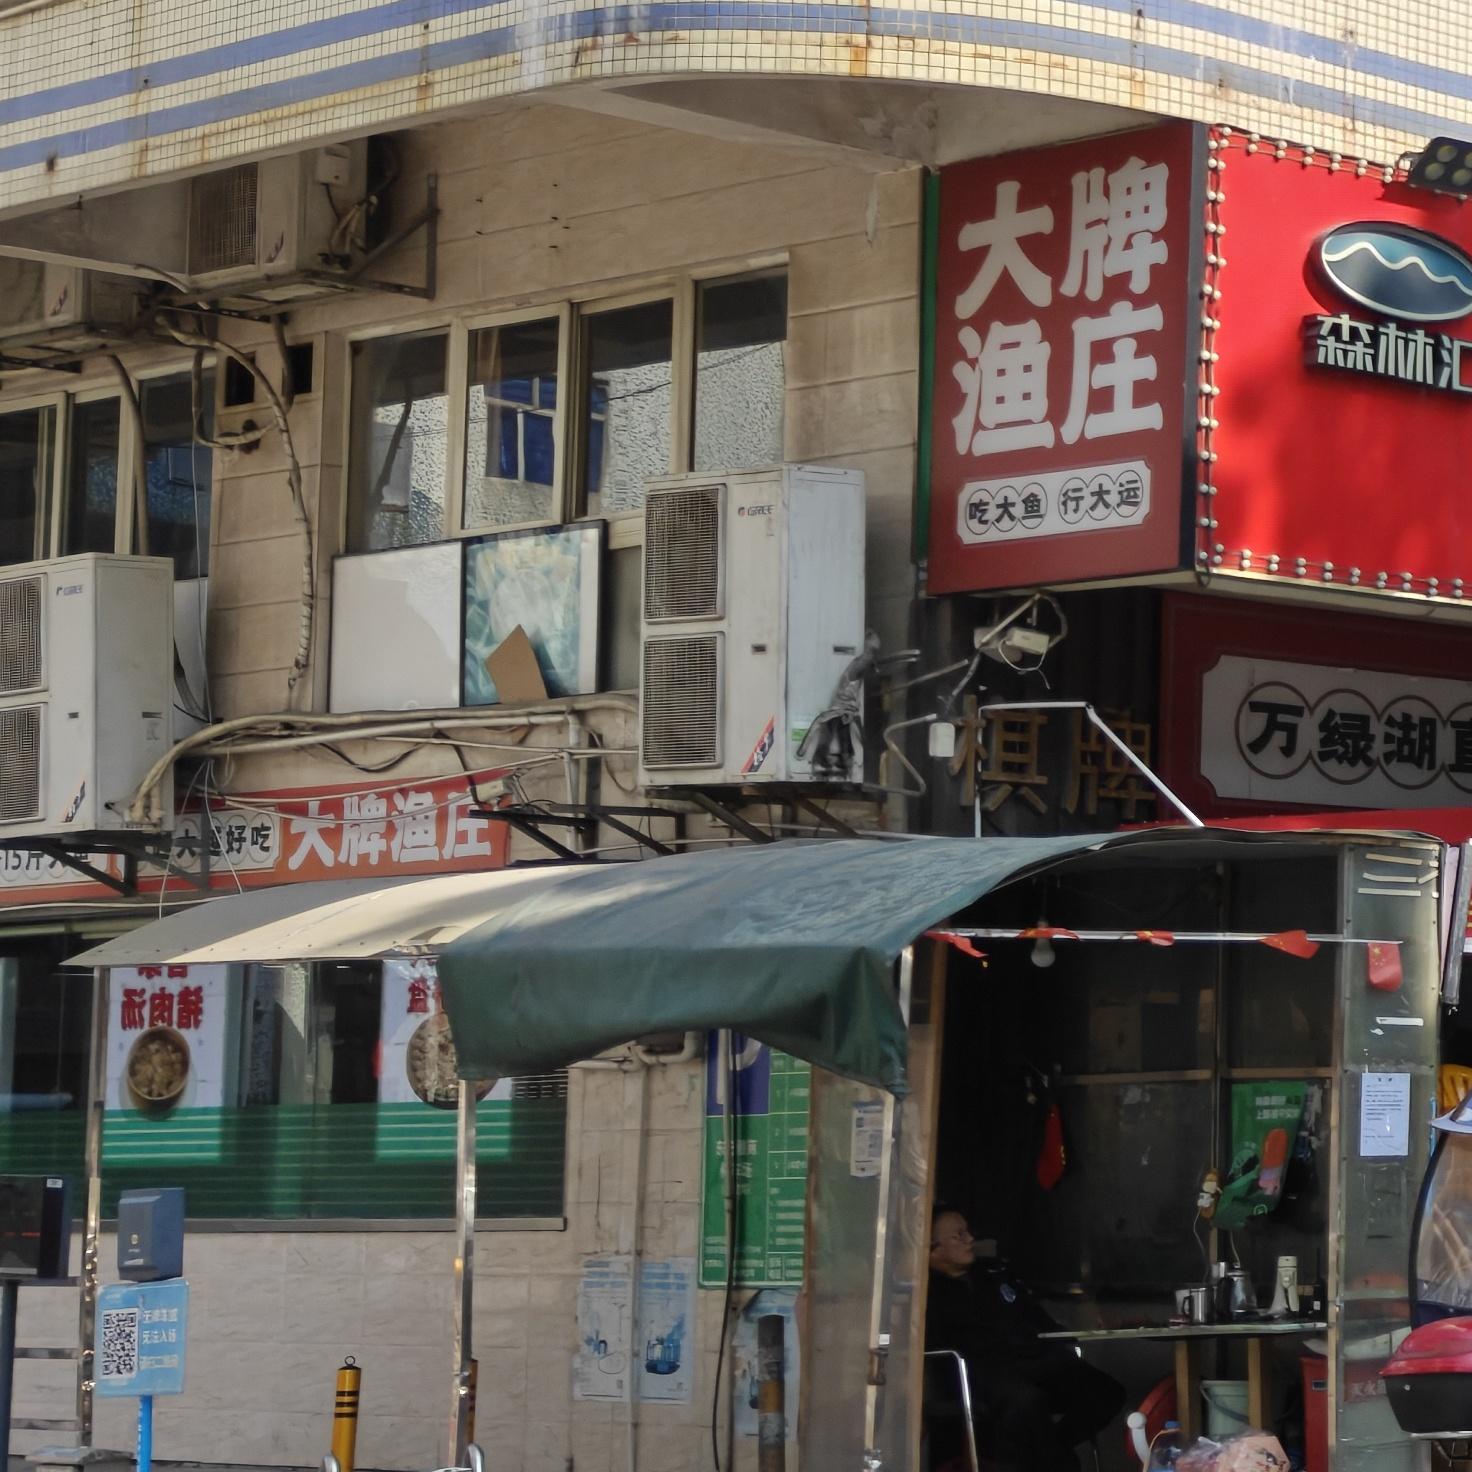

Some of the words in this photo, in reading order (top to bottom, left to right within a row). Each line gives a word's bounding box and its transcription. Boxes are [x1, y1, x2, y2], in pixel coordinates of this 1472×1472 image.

[953, 155, 1170, 320] 大牌
[951, 300, 1165, 457] 渔庄
[967, 487, 1047, 531] 吃大鱼
[1060, 473, 1143, 515] 行大运
[287, 780, 494, 872] 大牌渔庄
